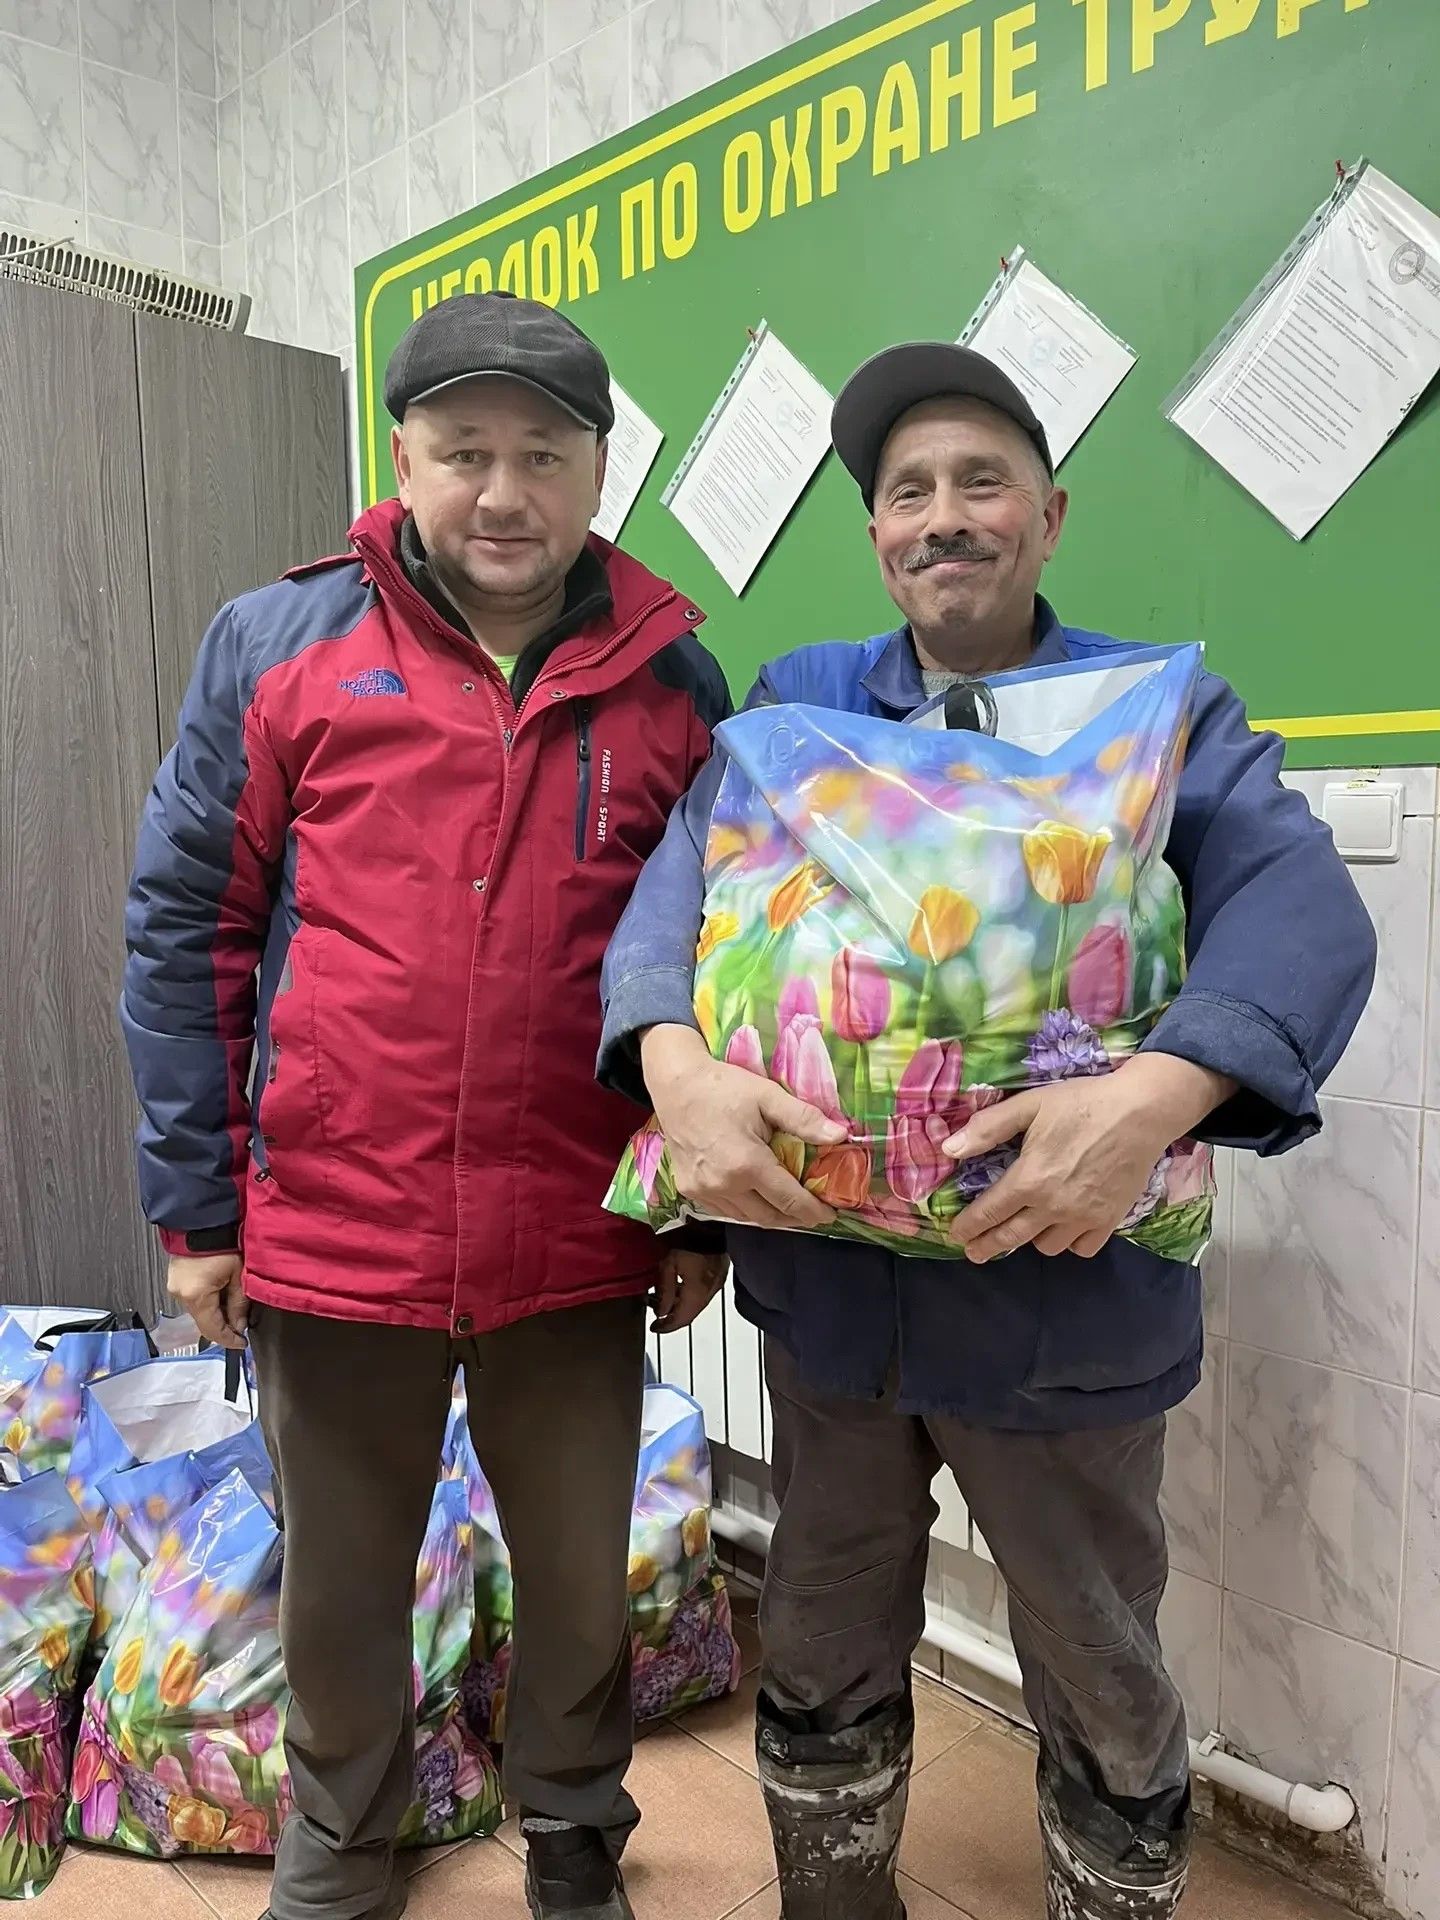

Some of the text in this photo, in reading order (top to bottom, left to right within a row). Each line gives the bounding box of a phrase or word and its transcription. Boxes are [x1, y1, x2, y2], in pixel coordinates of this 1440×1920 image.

[620, 161, 698, 280] ПО
[723, 2, 1037, 233] ОХРАНЕ
[1072, 0, 1369, 92] ТР
[359, 668, 383, 680] THE
[339, 676, 384, 690] NORTH
[353, 687, 385, 697] FACE
[596, 748, 612, 843] FASHION SPORT
